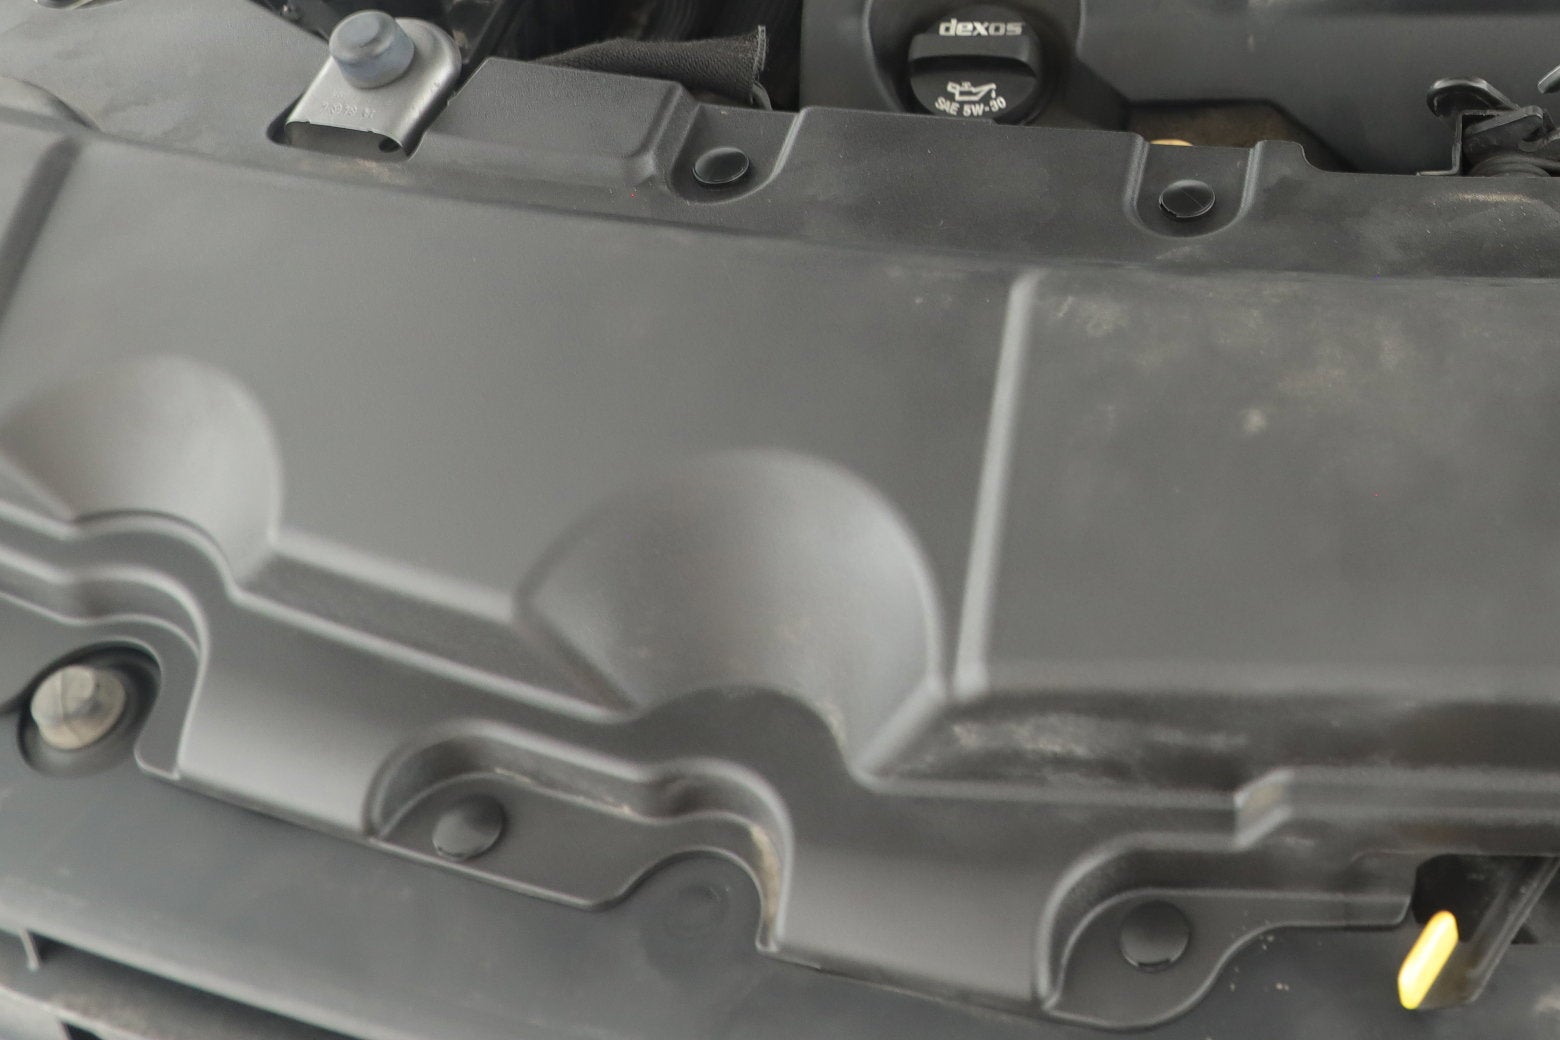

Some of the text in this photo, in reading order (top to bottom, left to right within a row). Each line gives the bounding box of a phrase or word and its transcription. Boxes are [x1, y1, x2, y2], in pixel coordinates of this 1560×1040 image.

[939, 18, 1023, 37] dexos
[935, 95, 1007, 117] SAE 5W-30
